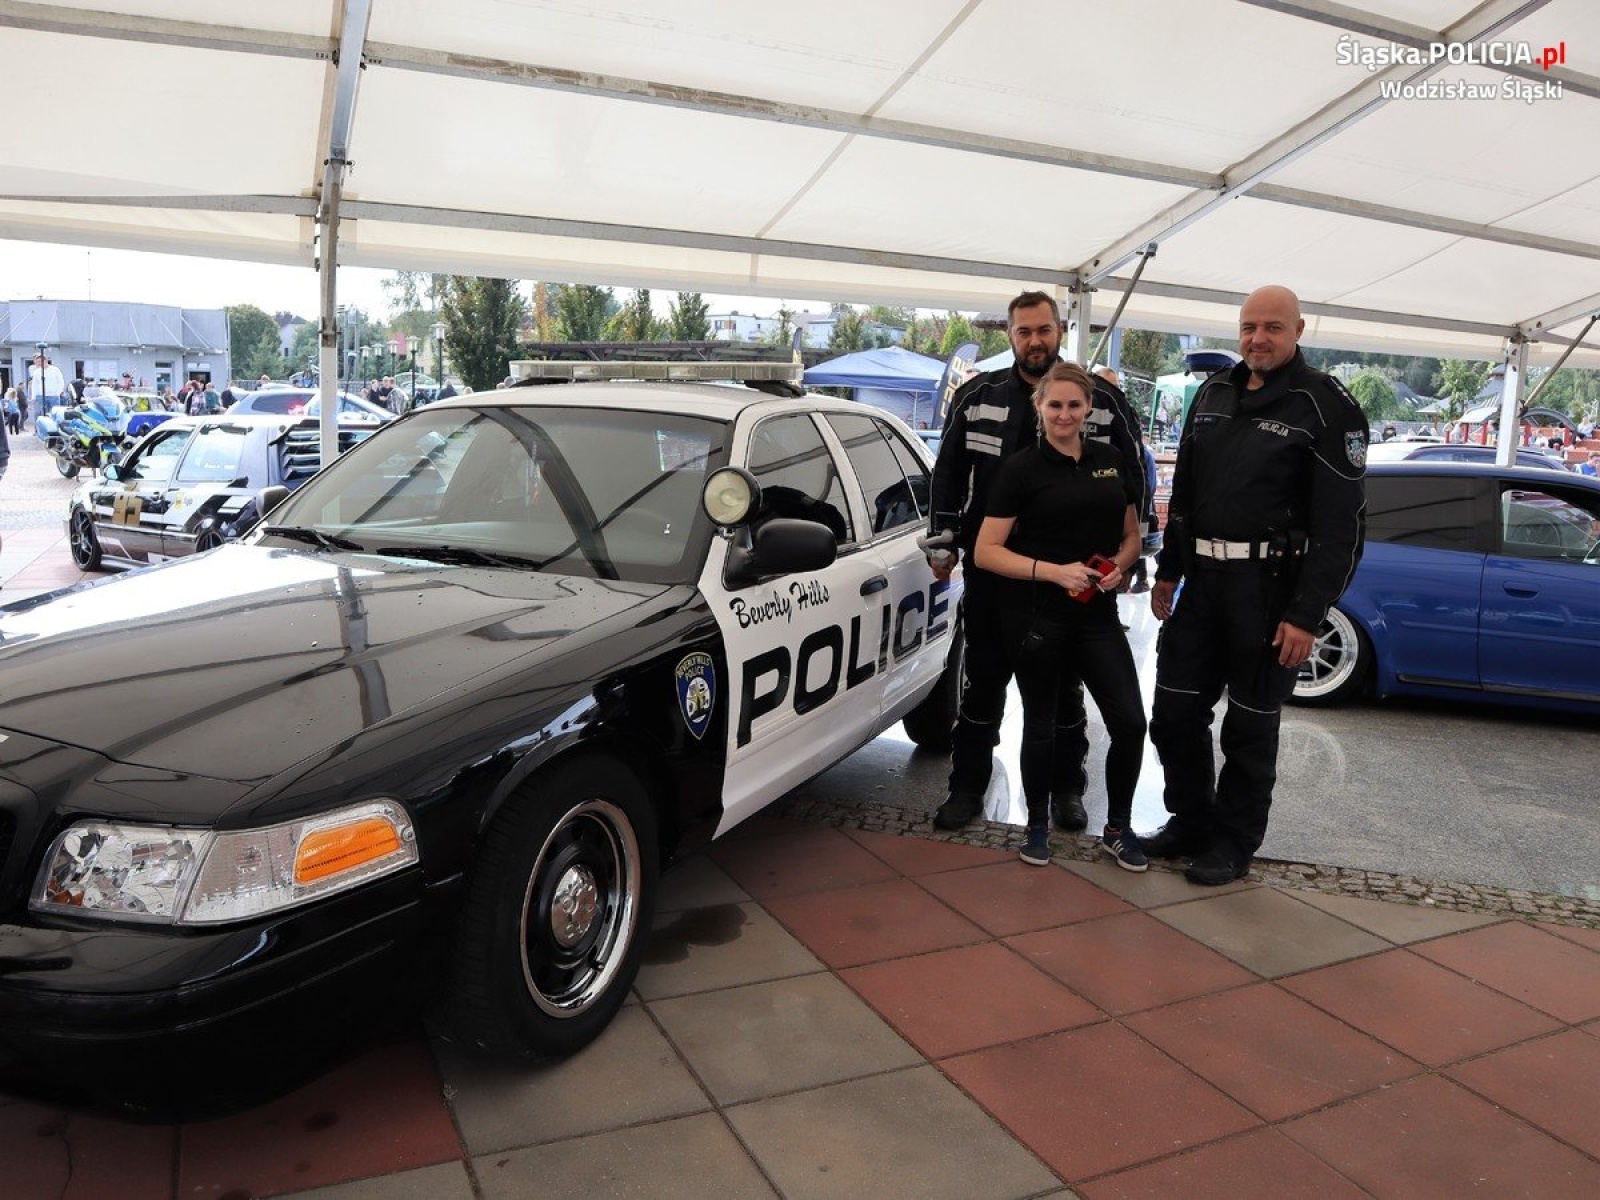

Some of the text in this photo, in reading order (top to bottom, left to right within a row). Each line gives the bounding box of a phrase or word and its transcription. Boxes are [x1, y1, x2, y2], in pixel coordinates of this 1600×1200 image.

[729, 581, 829, 628] Beverly Hills
[737, 579, 949, 749] POLICE
